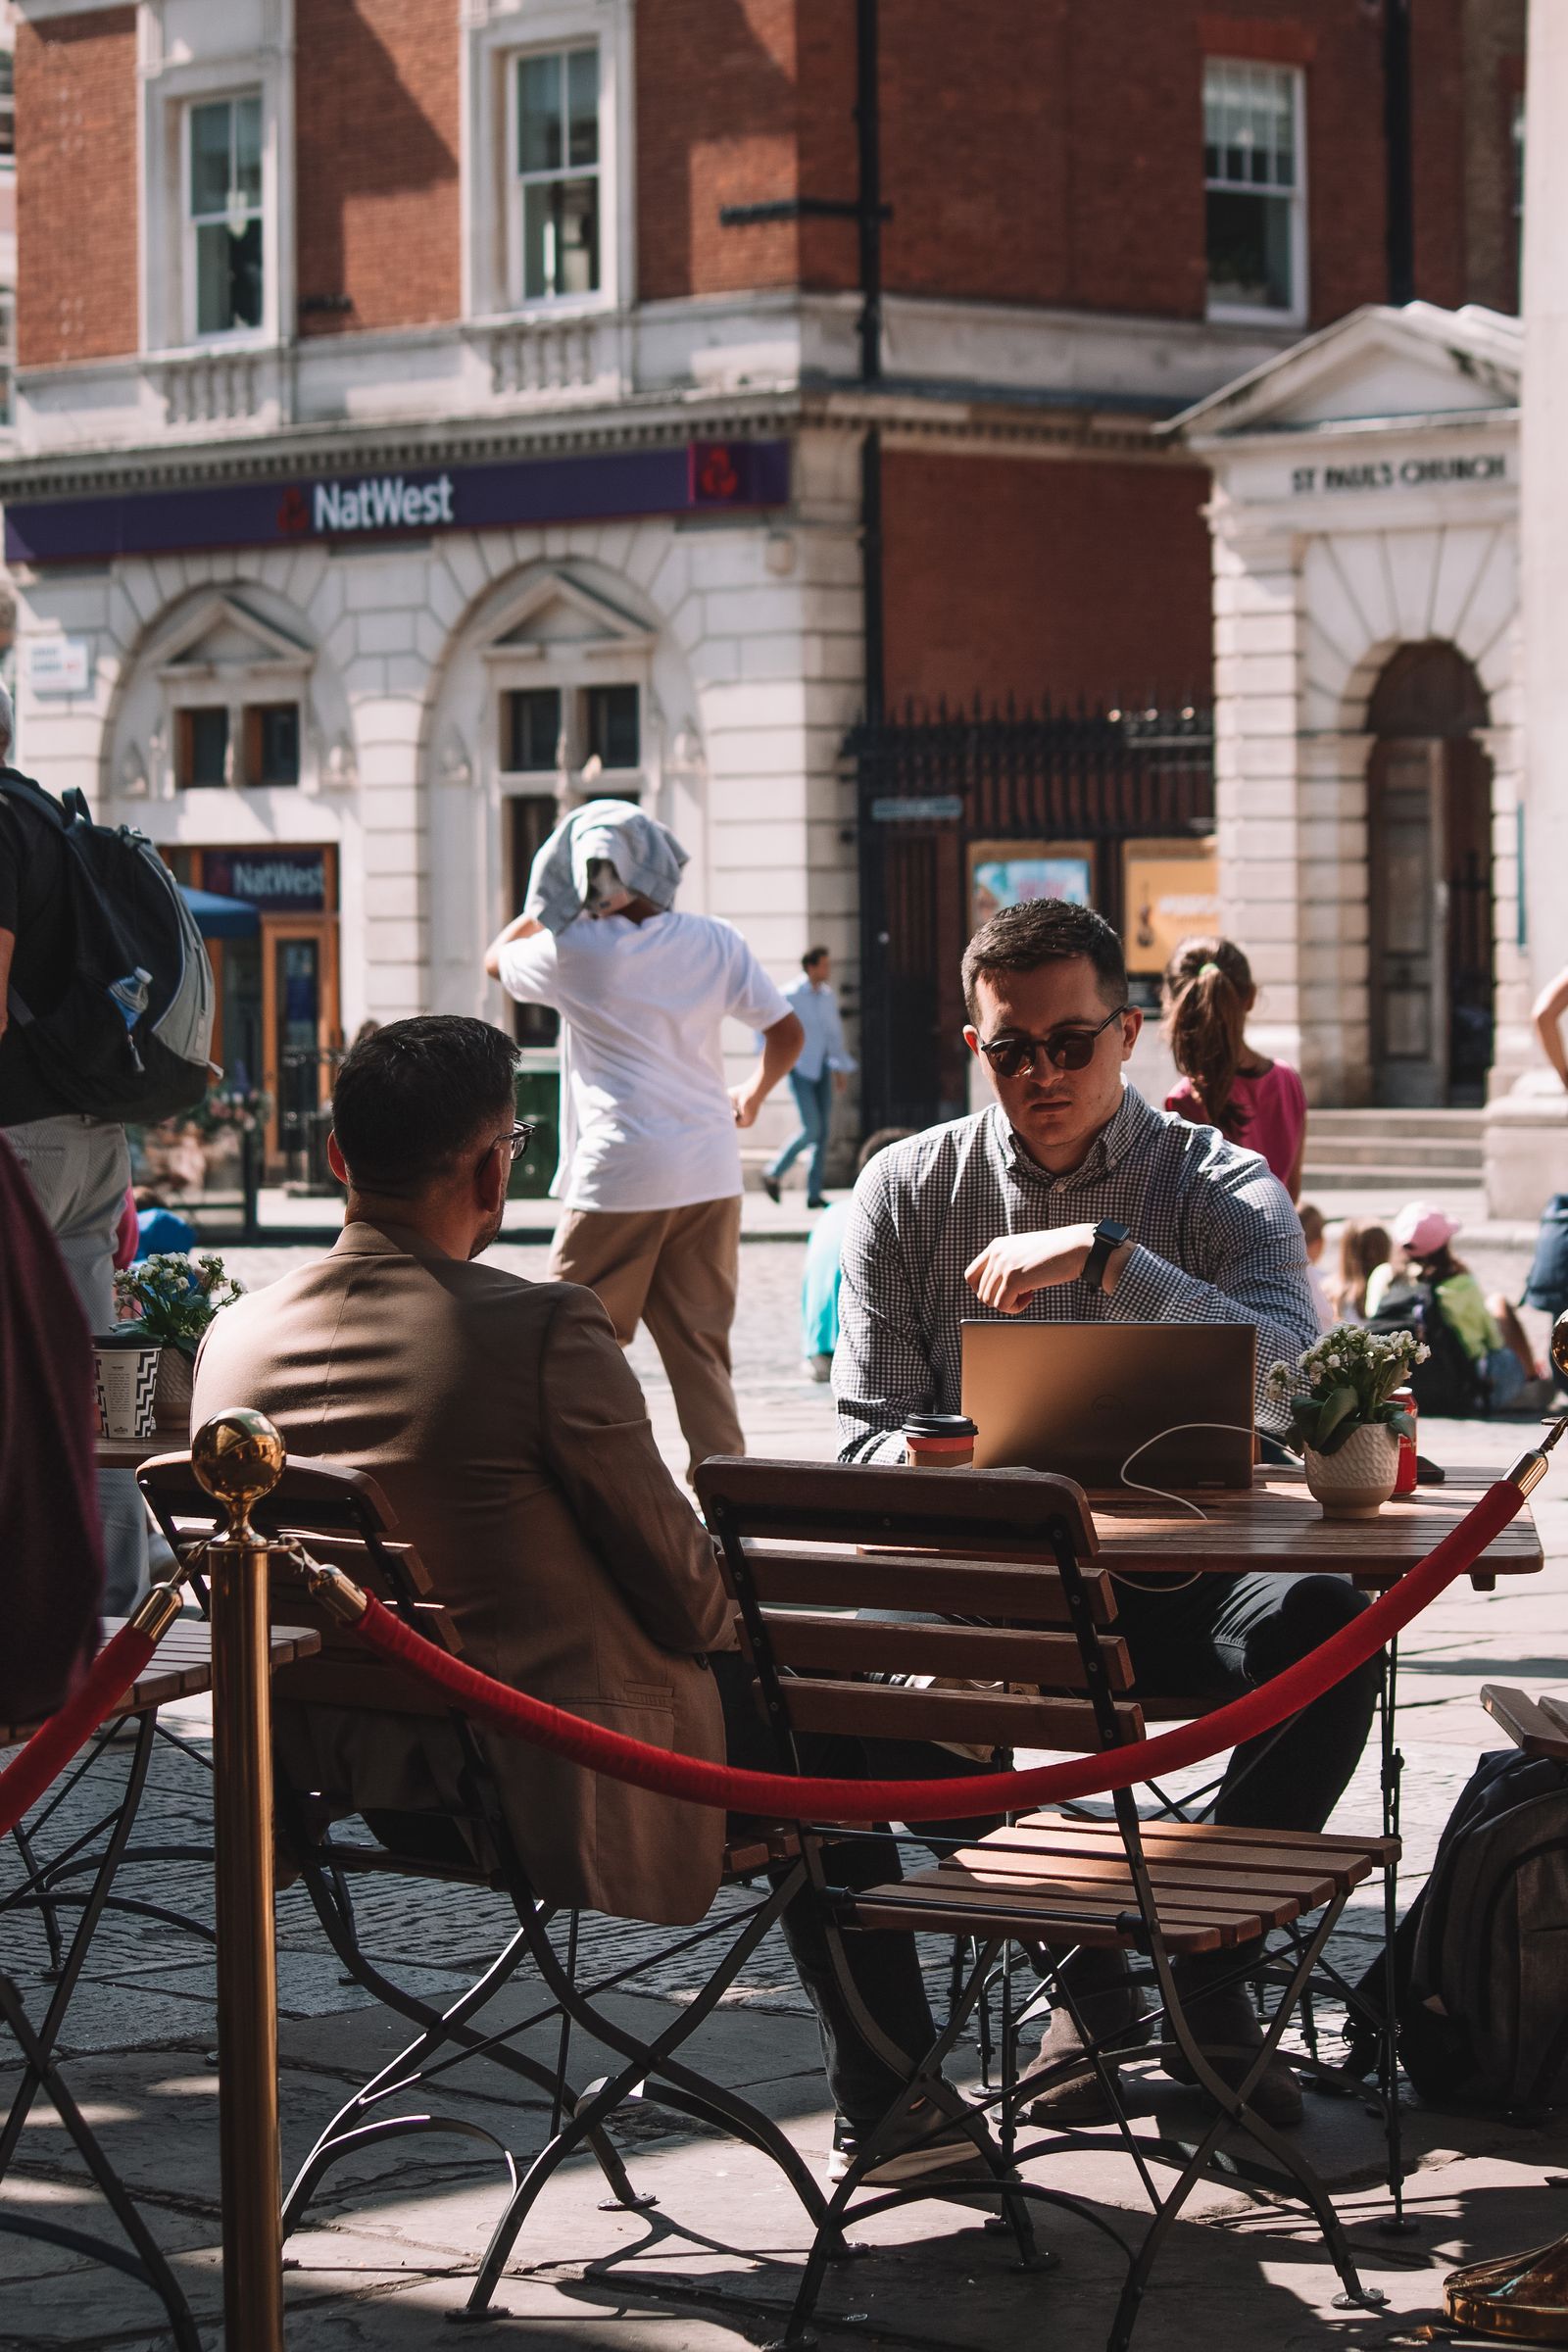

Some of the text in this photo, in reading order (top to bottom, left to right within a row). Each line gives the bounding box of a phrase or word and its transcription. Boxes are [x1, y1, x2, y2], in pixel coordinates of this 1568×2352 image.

[1293, 467, 1315, 492] ST
[1399, 454, 1506, 485] CHURCH
[314, 474, 453, 531] NatWest
